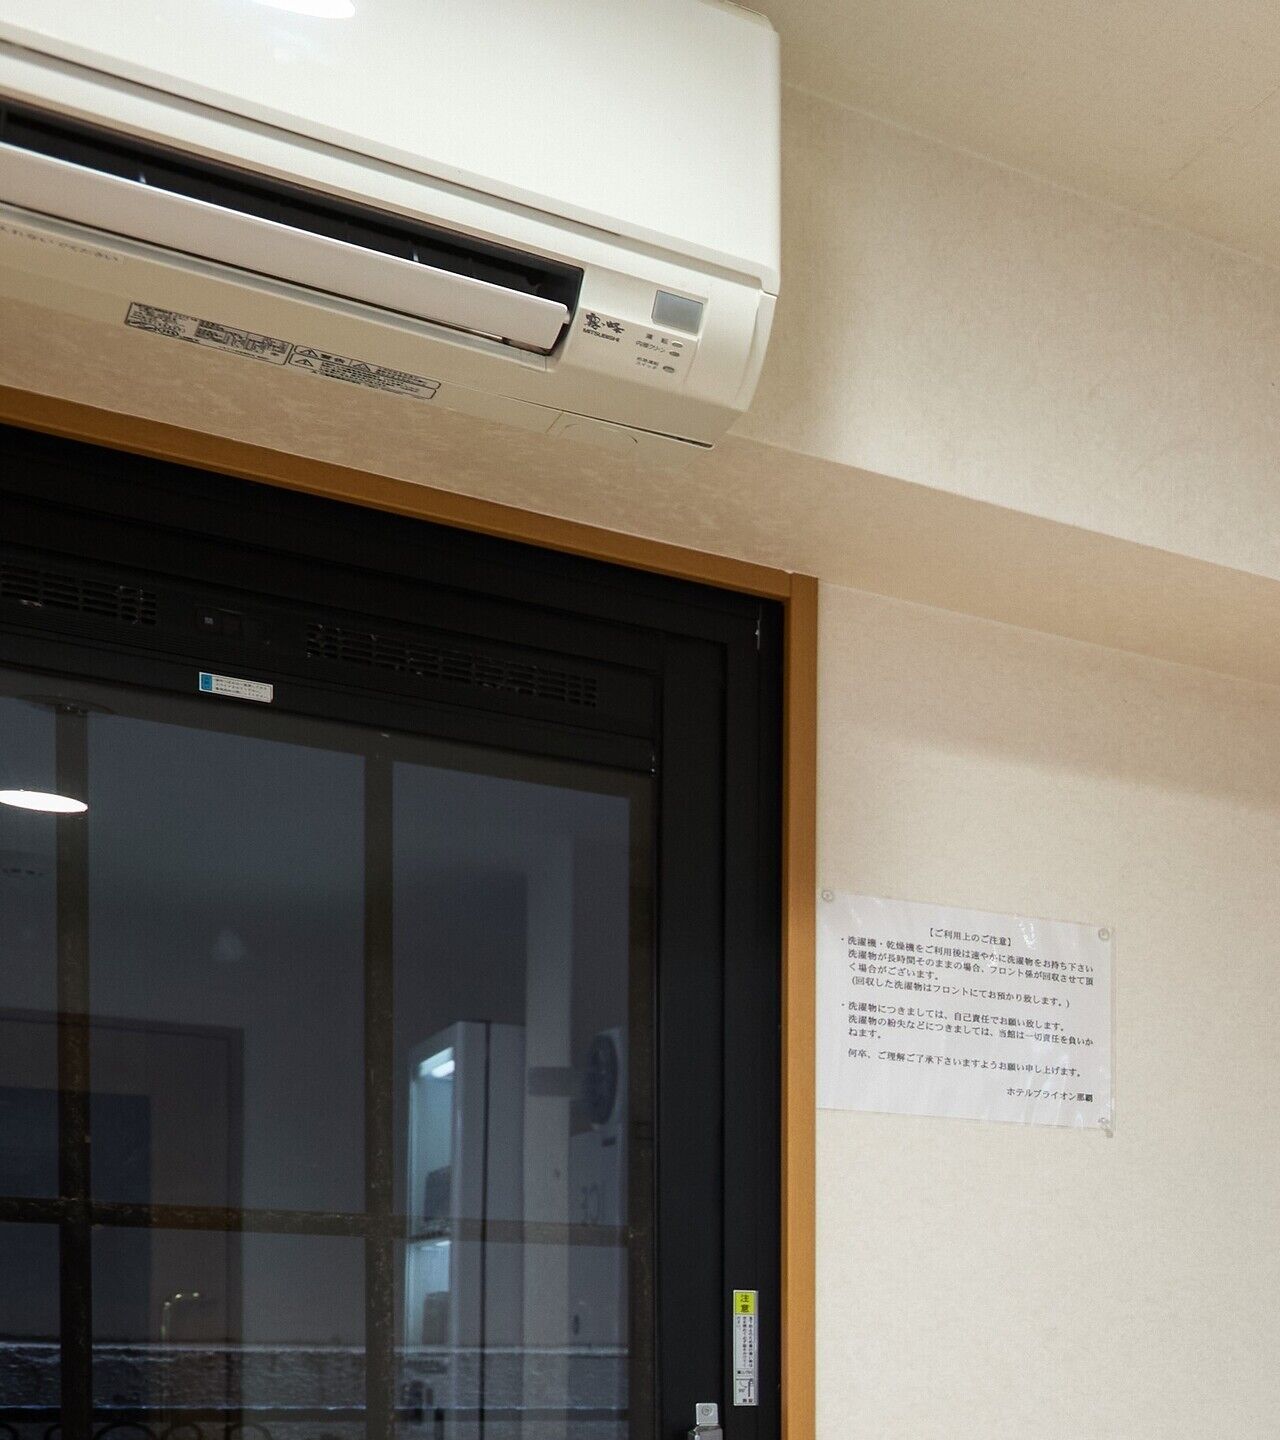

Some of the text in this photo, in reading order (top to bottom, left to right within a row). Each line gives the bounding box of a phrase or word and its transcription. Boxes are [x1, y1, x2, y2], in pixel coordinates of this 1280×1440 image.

[929, 927, 1012, 947] 【ご利用上のご注意】
[849, 962, 938, 981] く場合がございます。
[848, 1027, 881, 1039] ねます。
